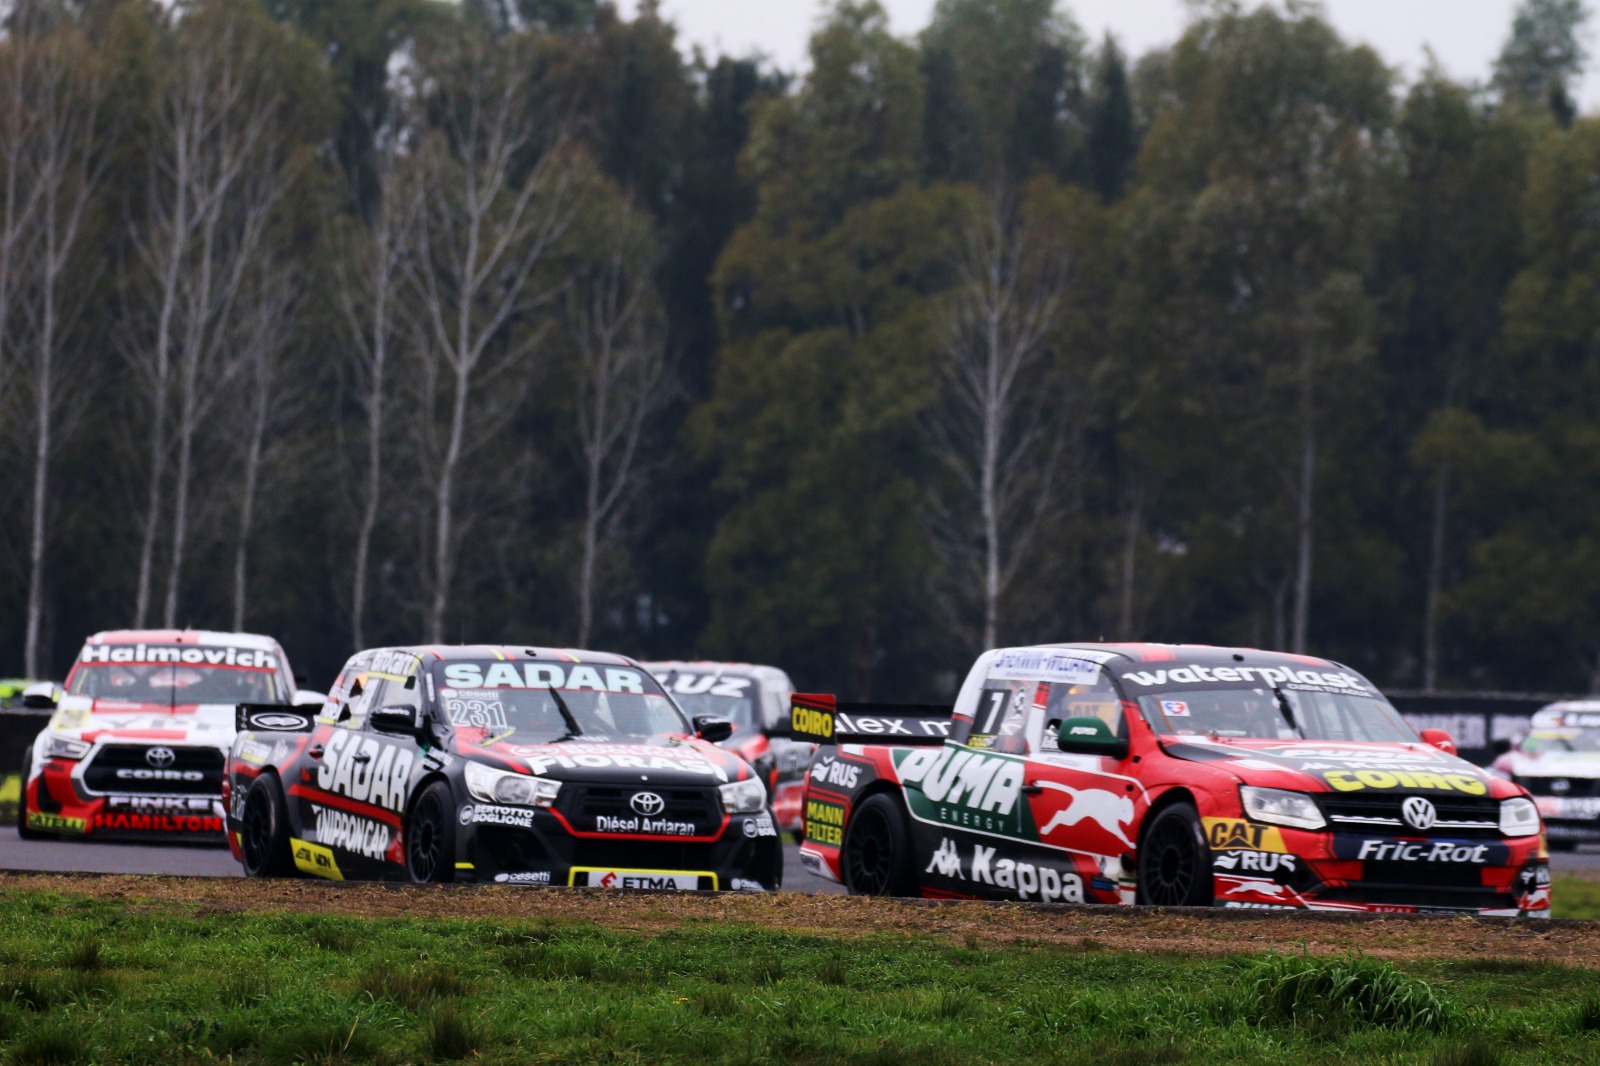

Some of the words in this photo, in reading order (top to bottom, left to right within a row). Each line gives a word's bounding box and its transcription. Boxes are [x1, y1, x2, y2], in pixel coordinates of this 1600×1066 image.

[82, 643, 278, 668] Haimovich
[445, 663, 643, 694] SADAR
[1122, 664, 1366, 691] waterplast
[448, 699, 508, 729] 231
[793, 706, 832, 738] COIRO
[317, 729, 413, 812] SADAR
[524, 753, 729, 784] FIORASI
[900, 748, 1024, 816] PUMA
[1323, 770, 1487, 796] COIRO
[95, 813, 221, 832] HAMILTON
[472, 813, 534, 828] BOGLIONE
[474, 803, 535, 819] BERTOTTO
[807, 801, 844, 826] MANN
[940, 809, 1004, 833] ENERGY
[806, 821, 843, 847] FILTER
[1210, 822, 1269, 849] CAT
[1357, 839, 1490, 863] Fric-Rot
[508, 871, 551, 882] cesetti
[622, 876, 677, 890] ETMA
[971, 844, 1085, 904] Kappa
